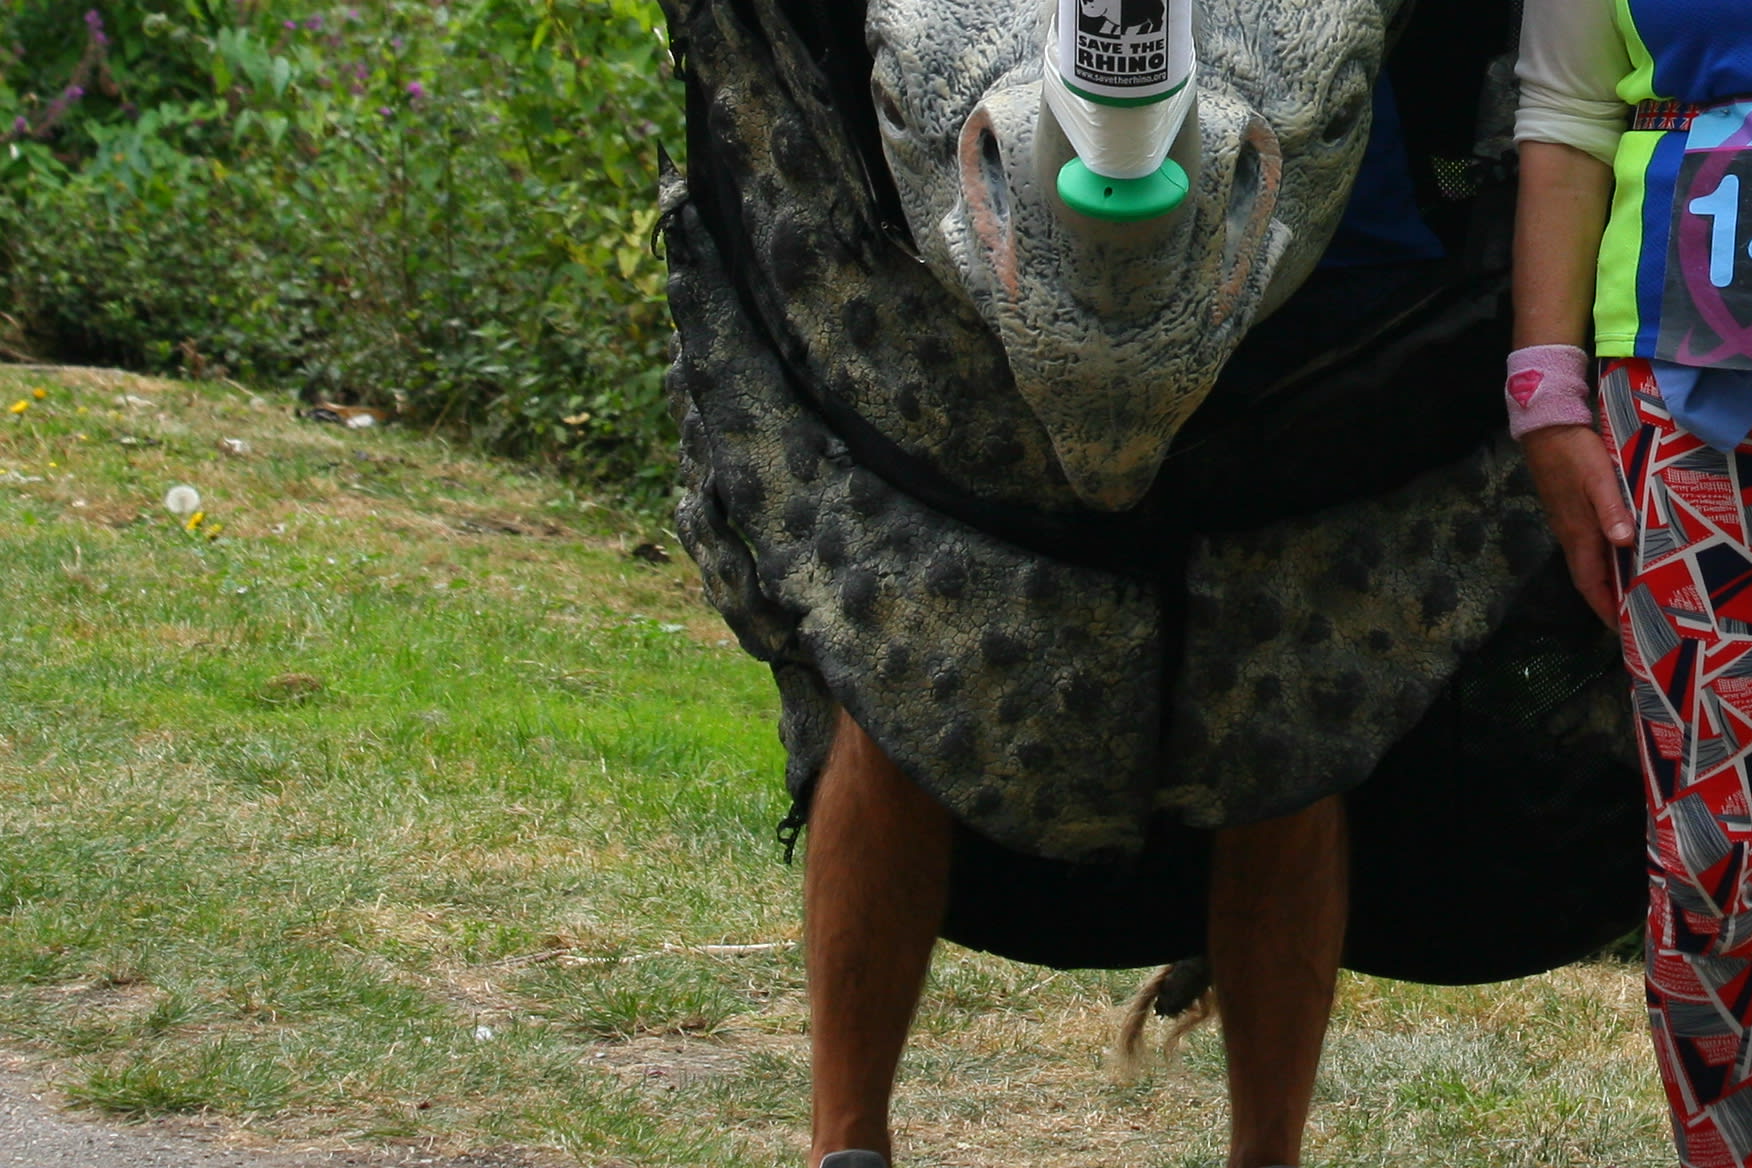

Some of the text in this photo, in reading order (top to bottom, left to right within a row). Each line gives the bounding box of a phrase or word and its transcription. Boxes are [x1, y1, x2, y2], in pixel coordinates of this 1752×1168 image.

[1078, 35, 1165, 54] SAVE THE
[1078, 47, 1165, 73] RHINO
